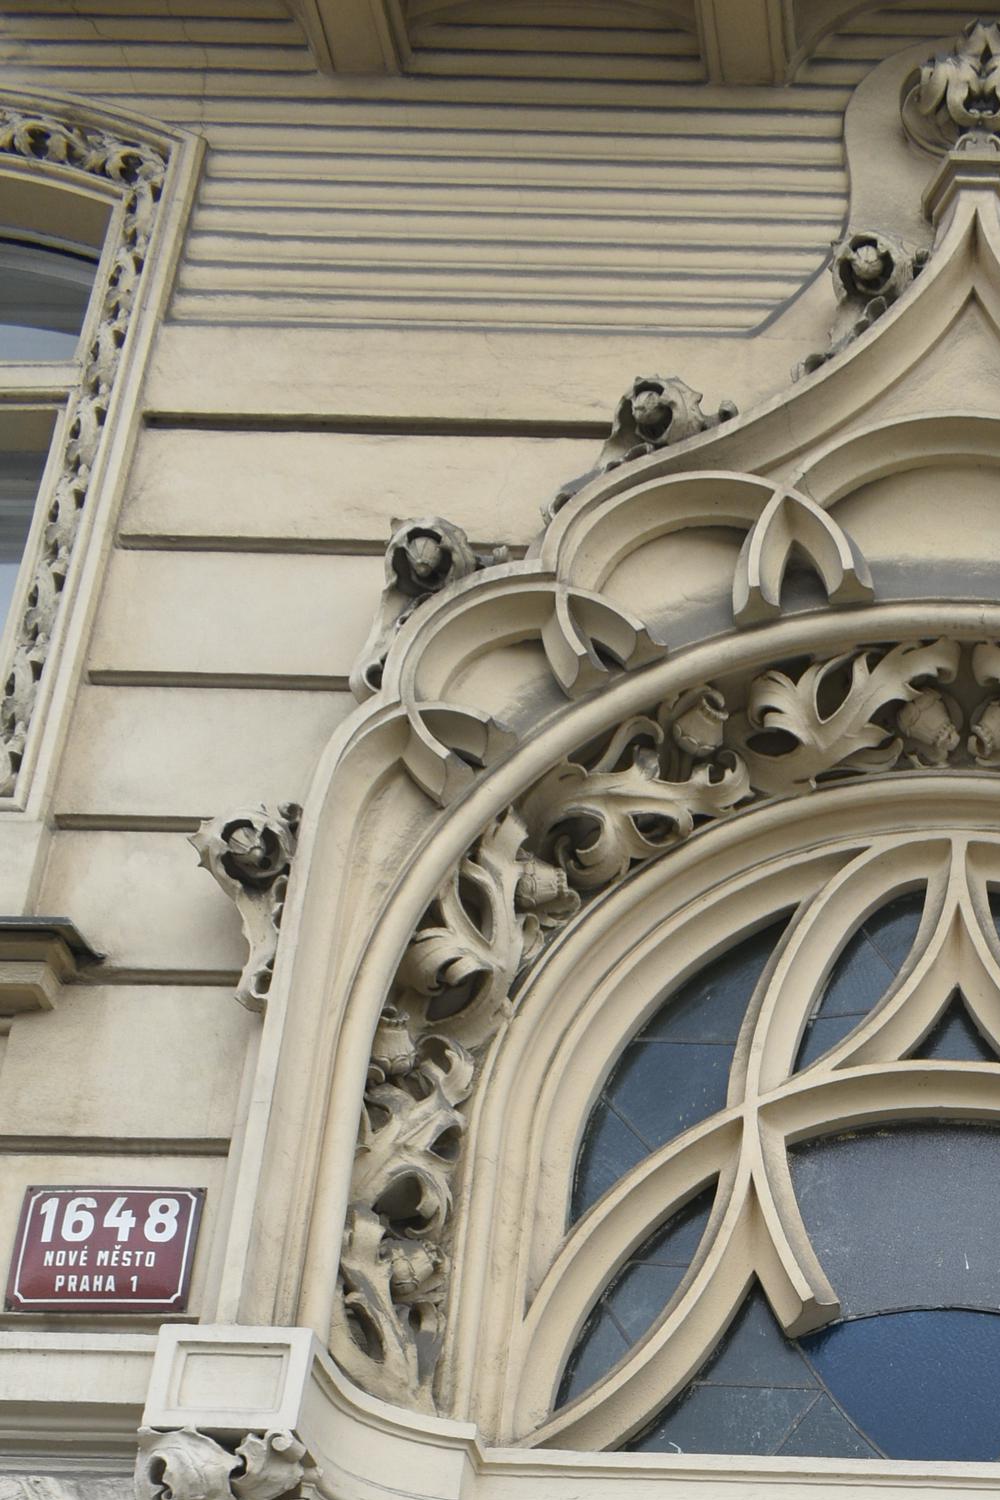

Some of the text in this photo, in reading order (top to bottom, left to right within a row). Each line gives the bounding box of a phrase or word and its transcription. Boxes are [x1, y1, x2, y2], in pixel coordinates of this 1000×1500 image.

[40, 1197, 180, 1243] 1648
[43, 1244, 156, 1267] NOVÉ MĚSTO
[54, 1275, 138, 1292] PRAHA 1
